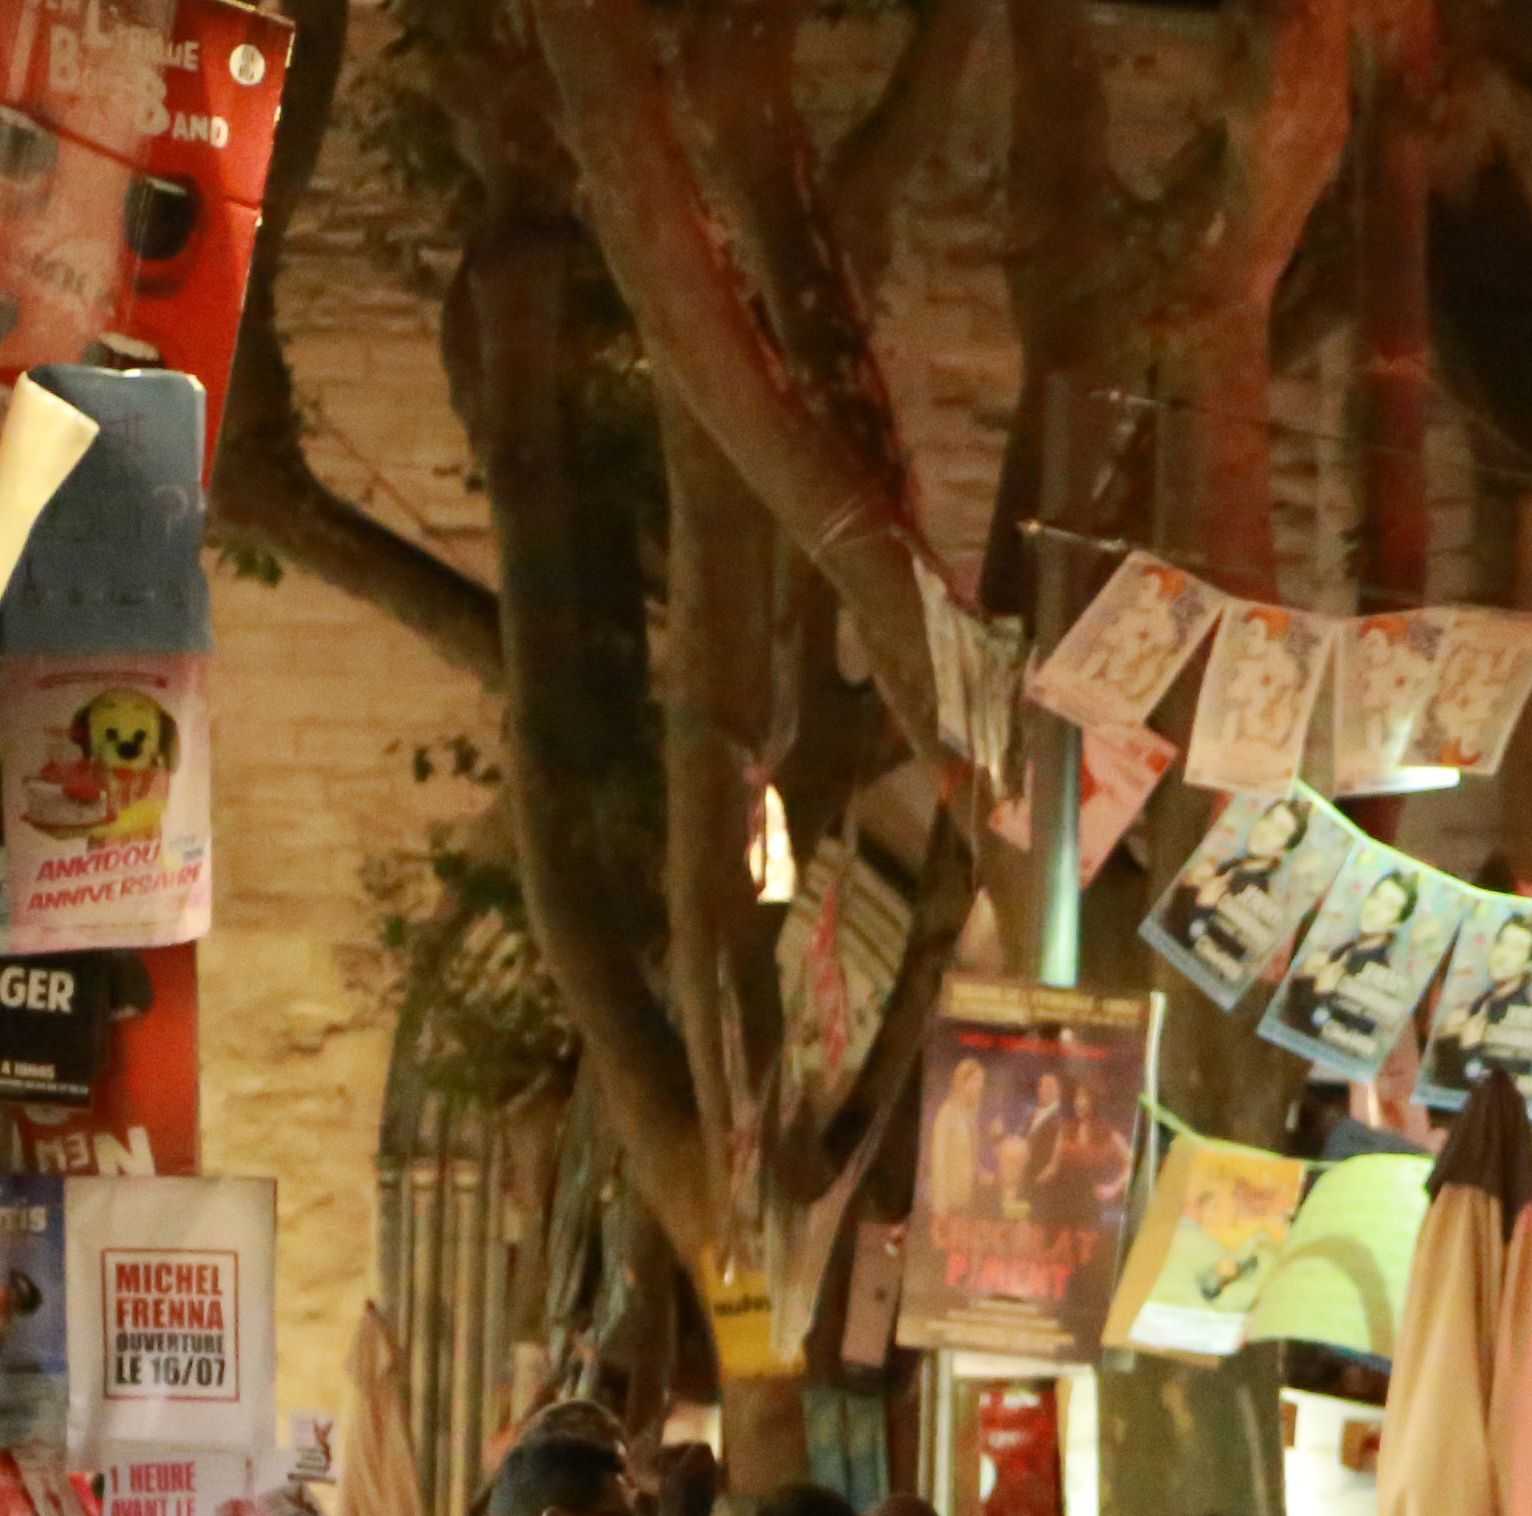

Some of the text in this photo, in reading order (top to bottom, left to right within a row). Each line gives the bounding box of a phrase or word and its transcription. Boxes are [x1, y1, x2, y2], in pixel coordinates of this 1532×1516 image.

[115, 1262, 223, 1296] MICHEL
[116, 1298, 224, 1330] FRENNA
[116, 1332, 224, 1354] OUVERTURE
[116, 1355, 142, 1385] LE
[129, 1461, 196, 1494] HEURE
